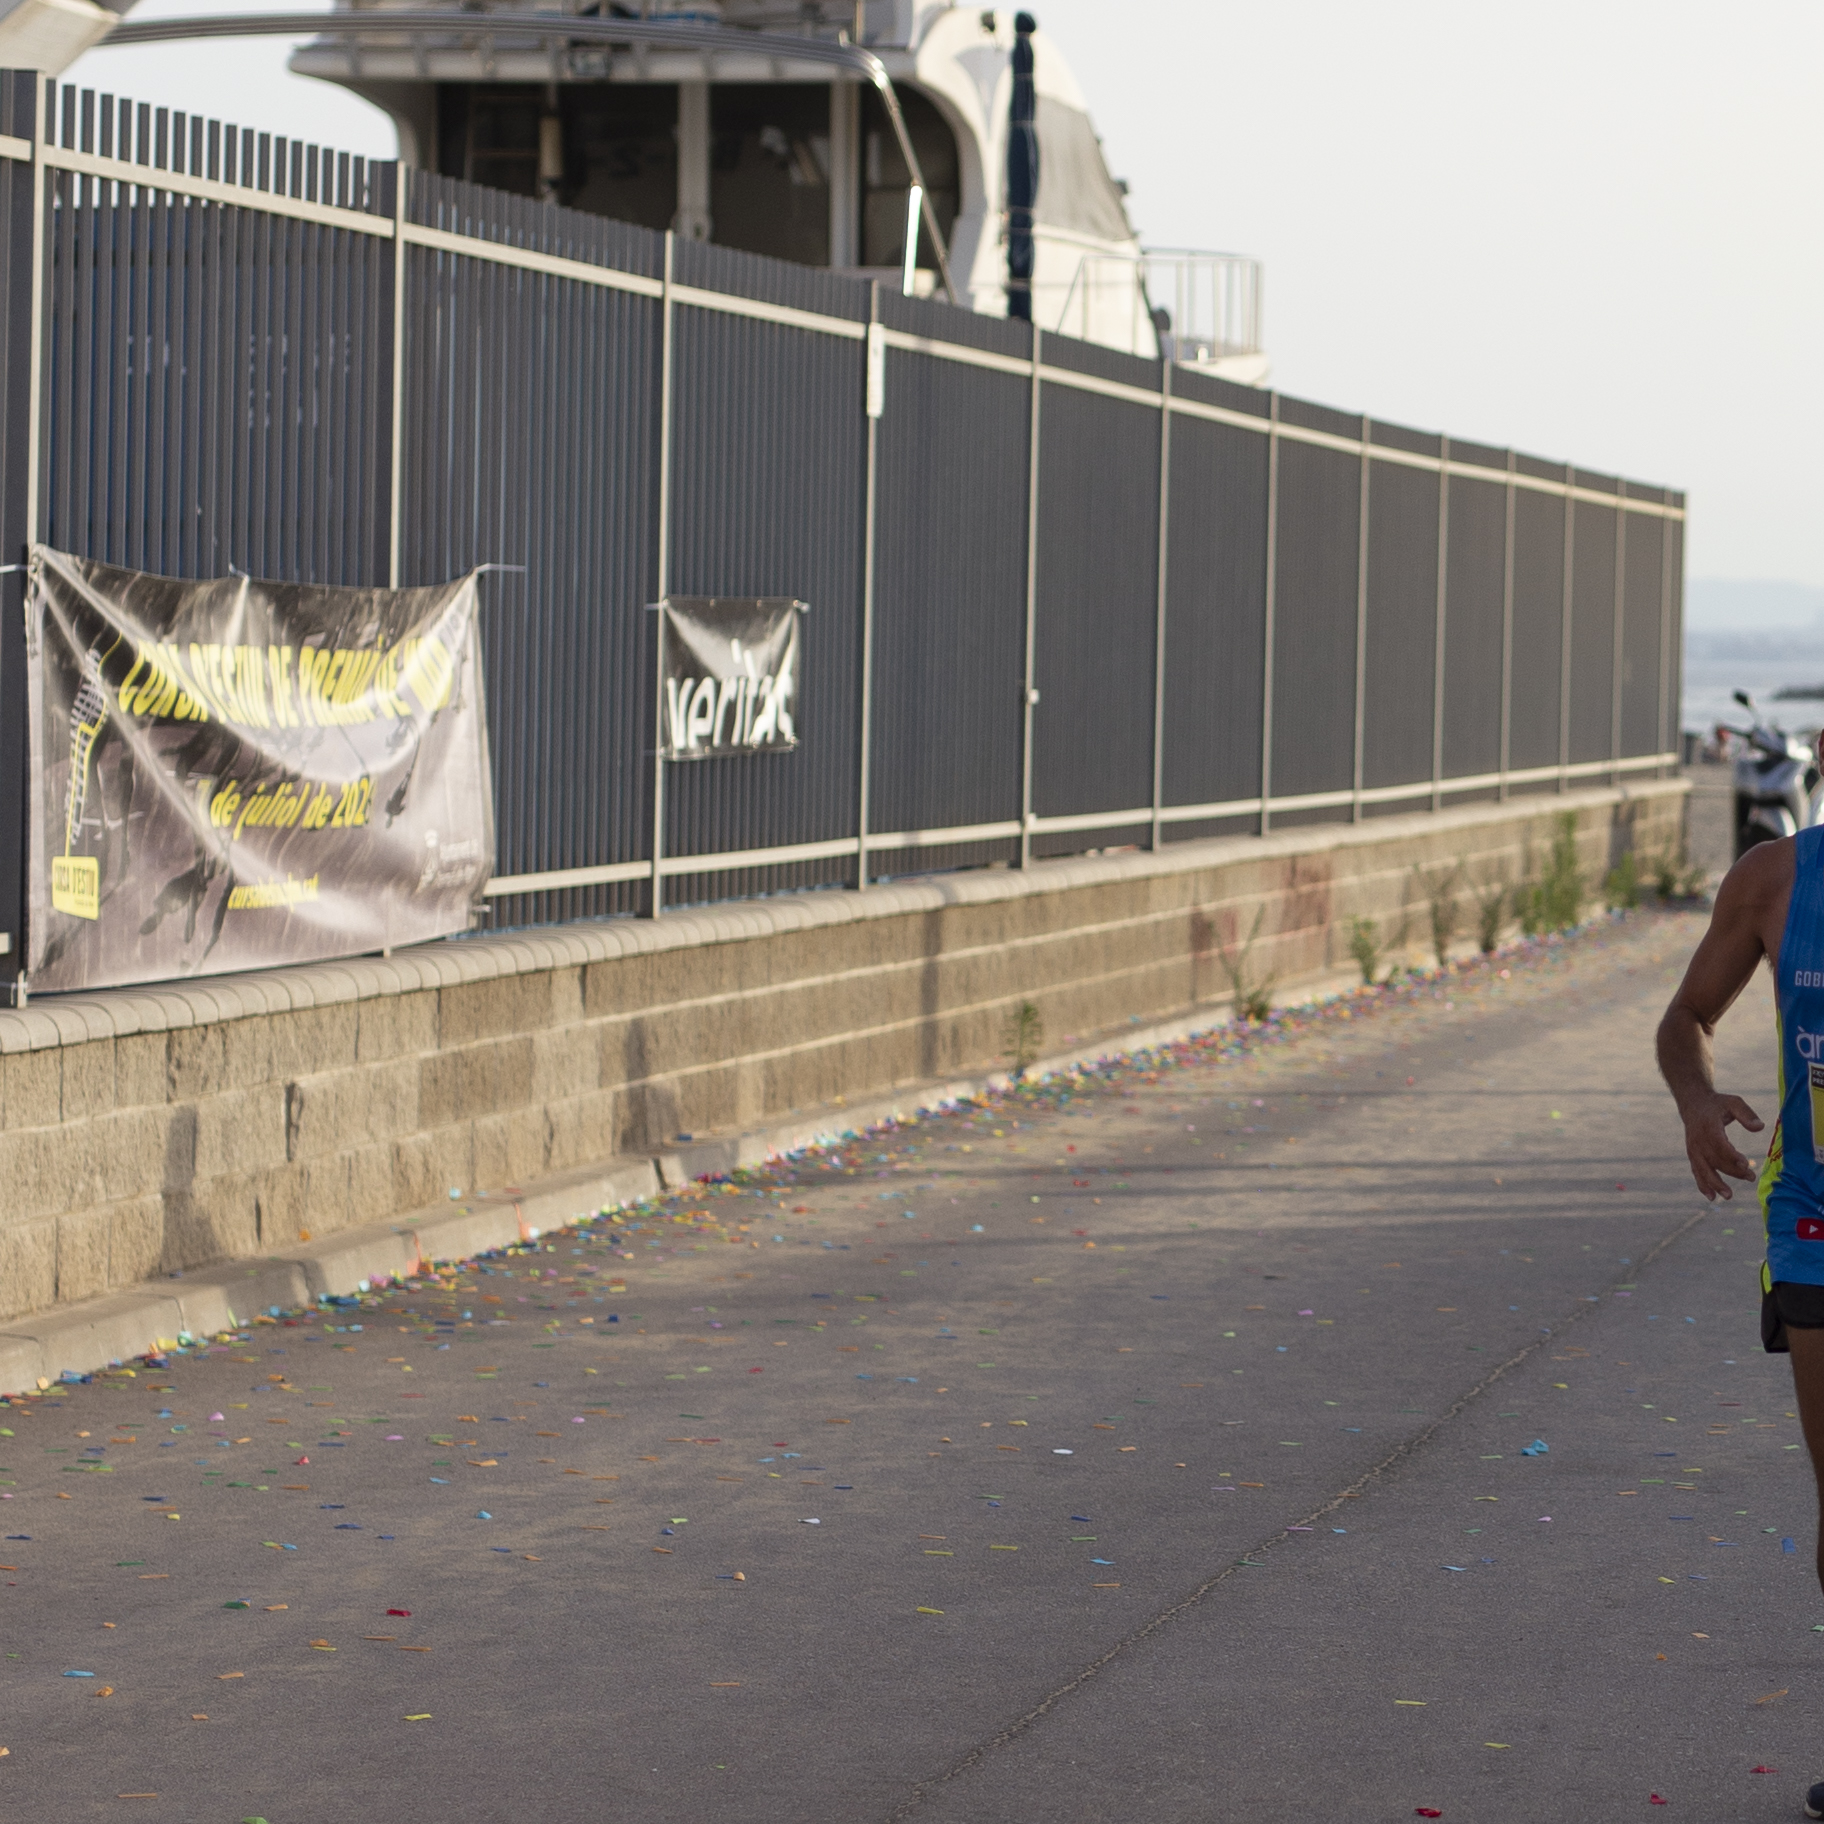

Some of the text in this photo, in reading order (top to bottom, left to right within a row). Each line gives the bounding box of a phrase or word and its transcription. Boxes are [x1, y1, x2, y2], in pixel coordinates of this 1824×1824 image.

[268, 644, 300, 729] DE
[667, 638, 793, 749] veritas
[210, 780, 242, 828] de
[233, 780, 310, 842] juliol
[302, 781, 333, 829] de
